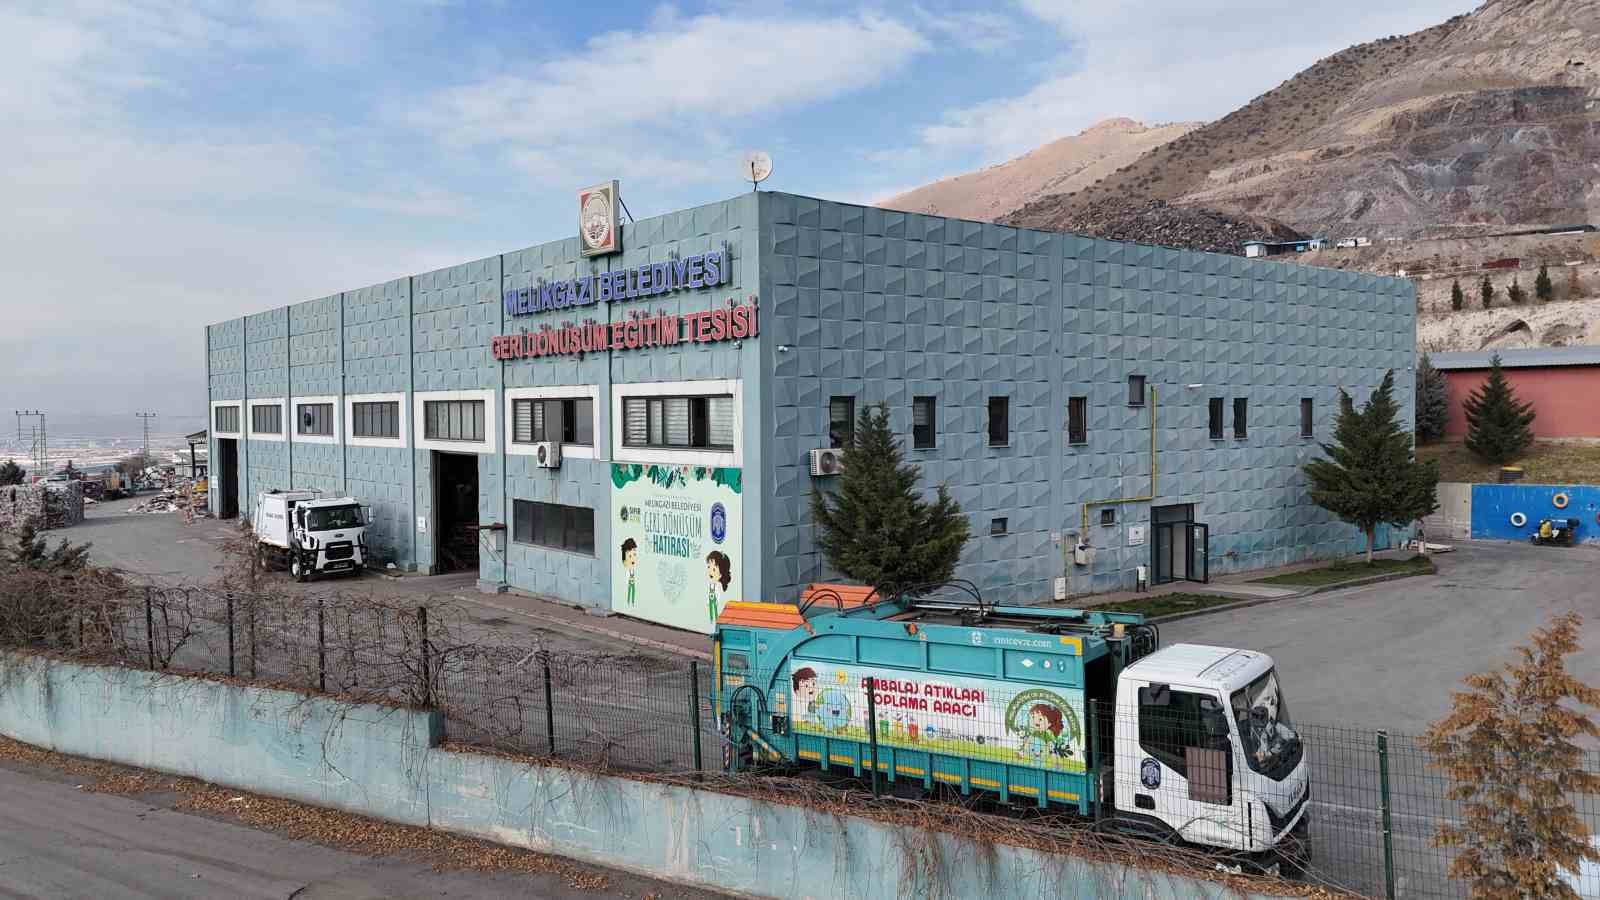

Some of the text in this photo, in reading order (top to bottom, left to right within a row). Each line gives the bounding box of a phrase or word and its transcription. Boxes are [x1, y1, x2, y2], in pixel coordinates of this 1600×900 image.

[600, 247, 727, 301] BELEDİYESİ
[611, 308, 678, 350] EĞİTİM
[684, 294, 758, 344] TESİSİ
[653, 534, 690, 558] HATIRASI
[861, 677, 985, 704] AMBALAJ ATIKLARI
[933, 699, 977, 718] ARACI
